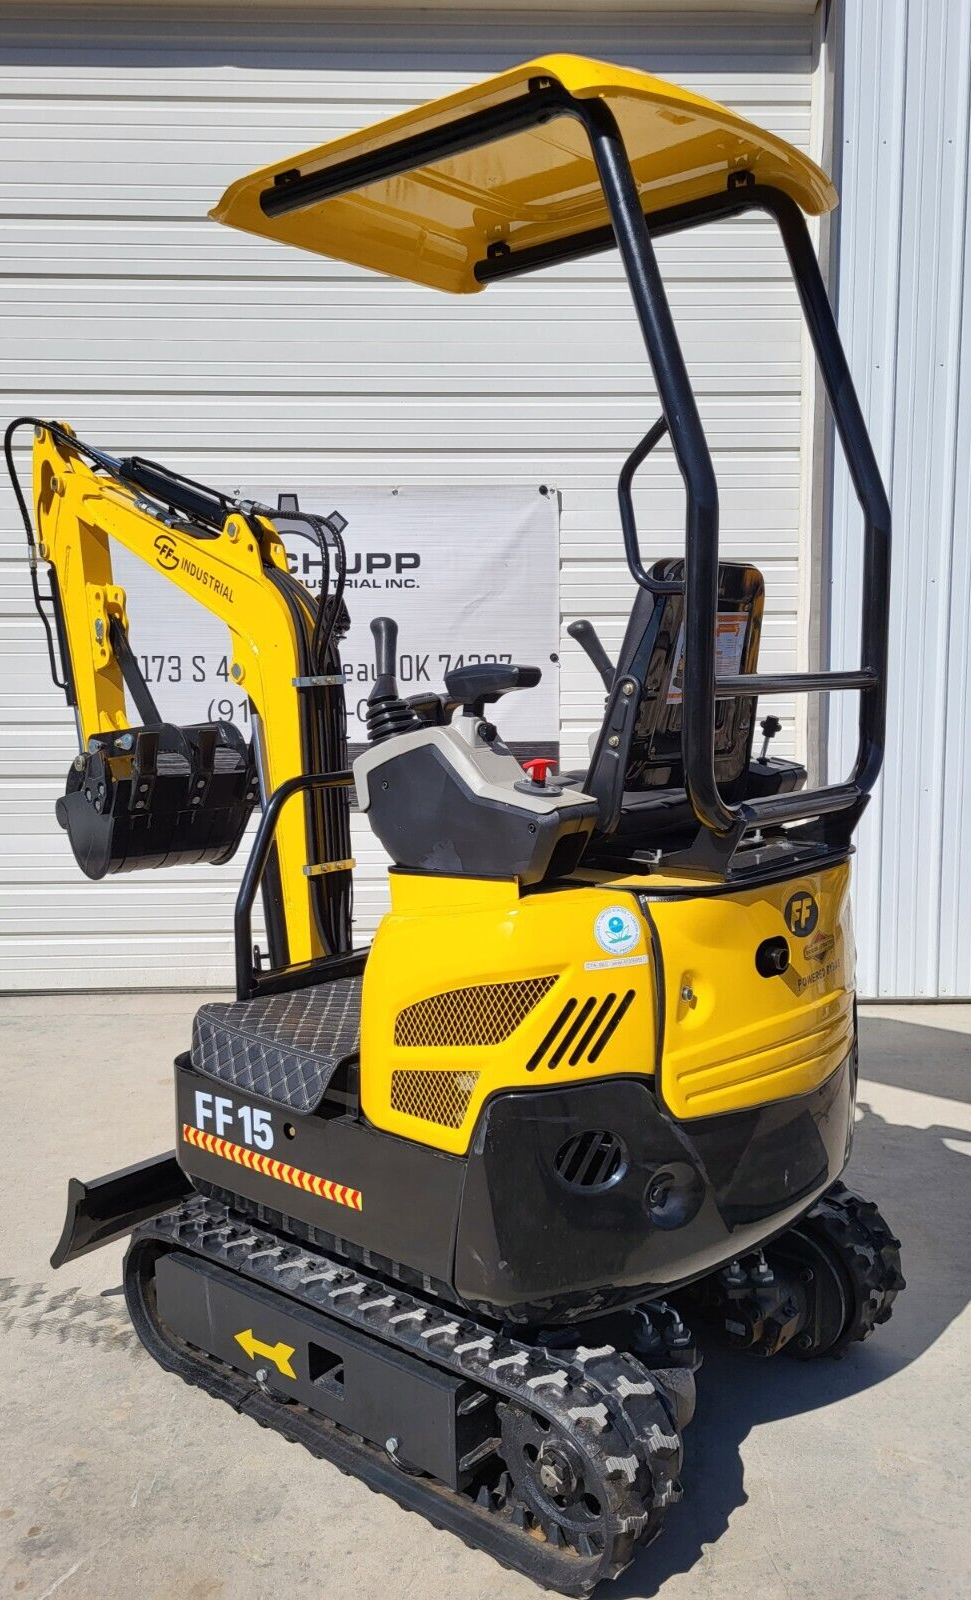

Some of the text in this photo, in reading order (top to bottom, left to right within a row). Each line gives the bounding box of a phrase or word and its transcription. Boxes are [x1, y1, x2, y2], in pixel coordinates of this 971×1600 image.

[181, 557, 234, 604] INDUSTRIAL
[385, 579, 420, 589] INC.
[133, 655, 182, 682] 173
[192, 655, 206, 682] S
[400, 654, 431, 682] OK
[791, 897, 812, 932] FF
